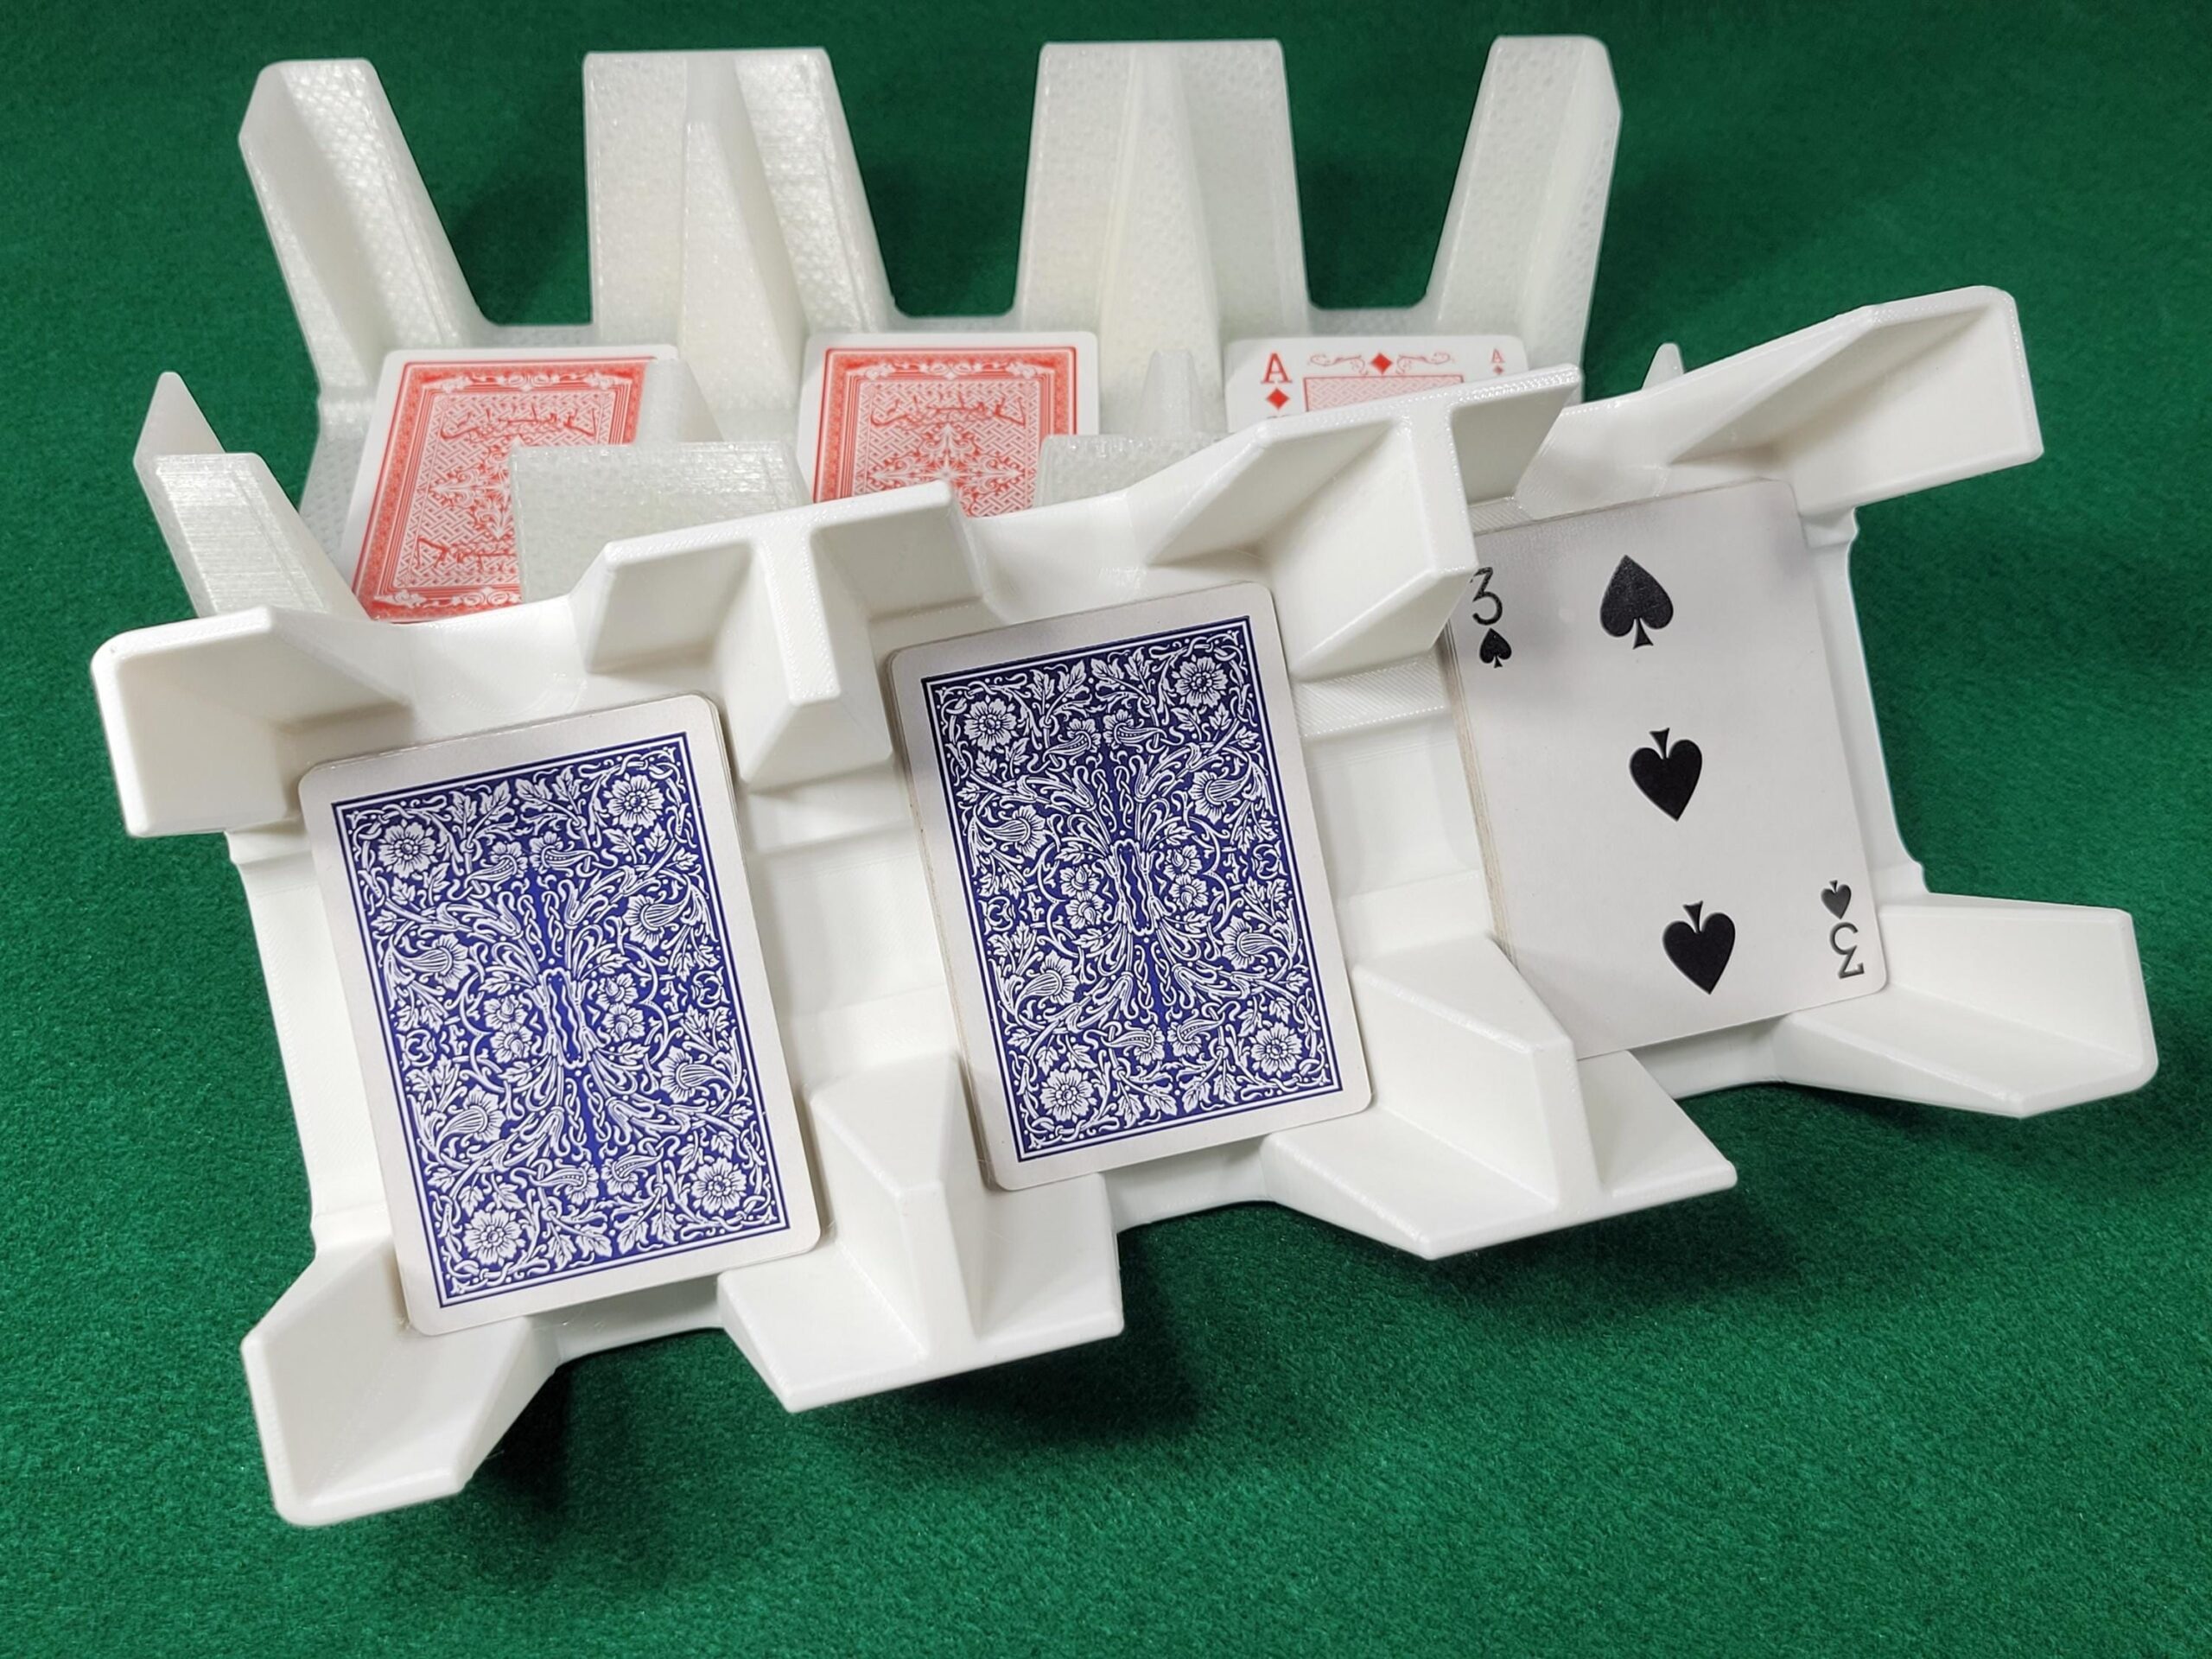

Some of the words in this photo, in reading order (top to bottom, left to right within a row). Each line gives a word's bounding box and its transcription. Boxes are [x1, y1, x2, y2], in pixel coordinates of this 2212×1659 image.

[1261, 353, 1293, 384] A
[1491, 349, 1505, 363] A
[1470, 567, 1503, 626] 3
[1830, 921, 1865, 979] 3
